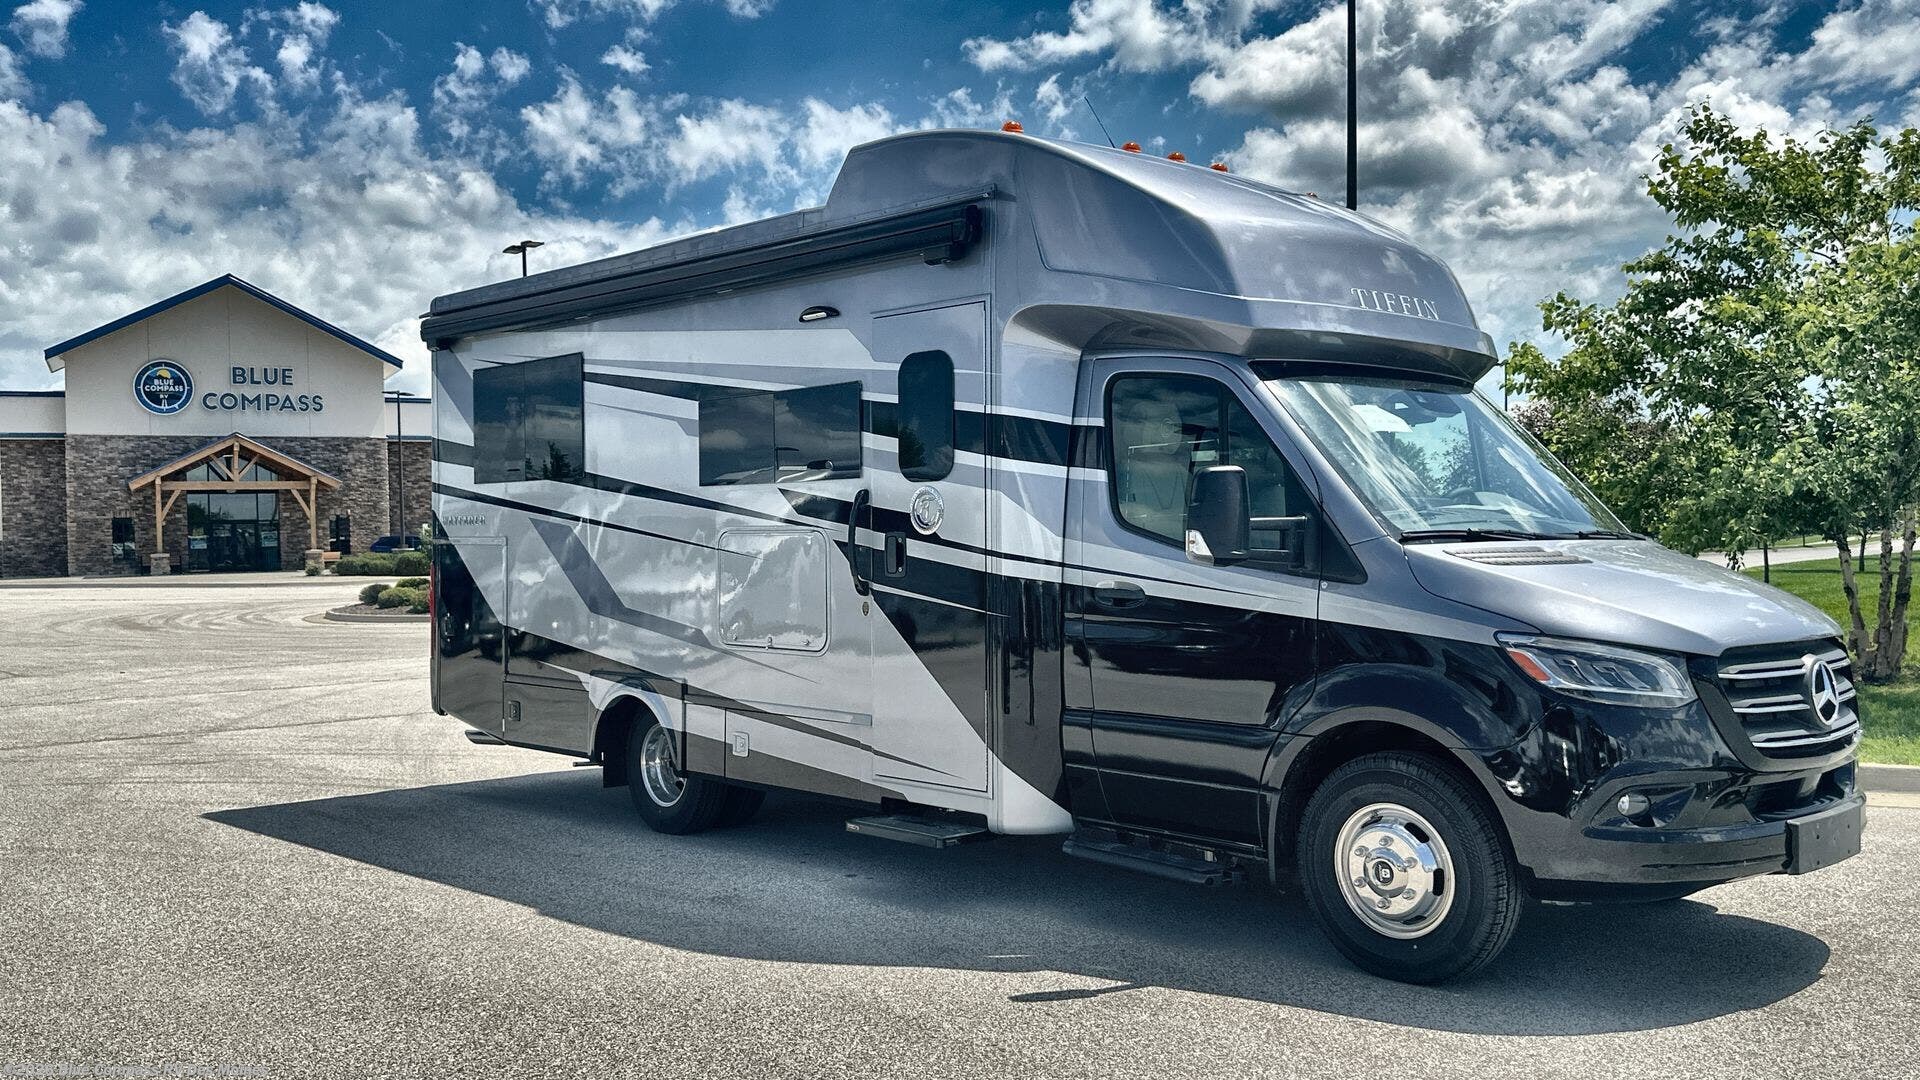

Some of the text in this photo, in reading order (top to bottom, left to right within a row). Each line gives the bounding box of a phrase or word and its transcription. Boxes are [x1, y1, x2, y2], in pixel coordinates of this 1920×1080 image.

[1350, 287, 1439, 321] TIFFIN
[153, 378, 174, 386] BLUE
[231, 366, 294, 386] BLUE
[202, 392, 324, 412] COMPASS
